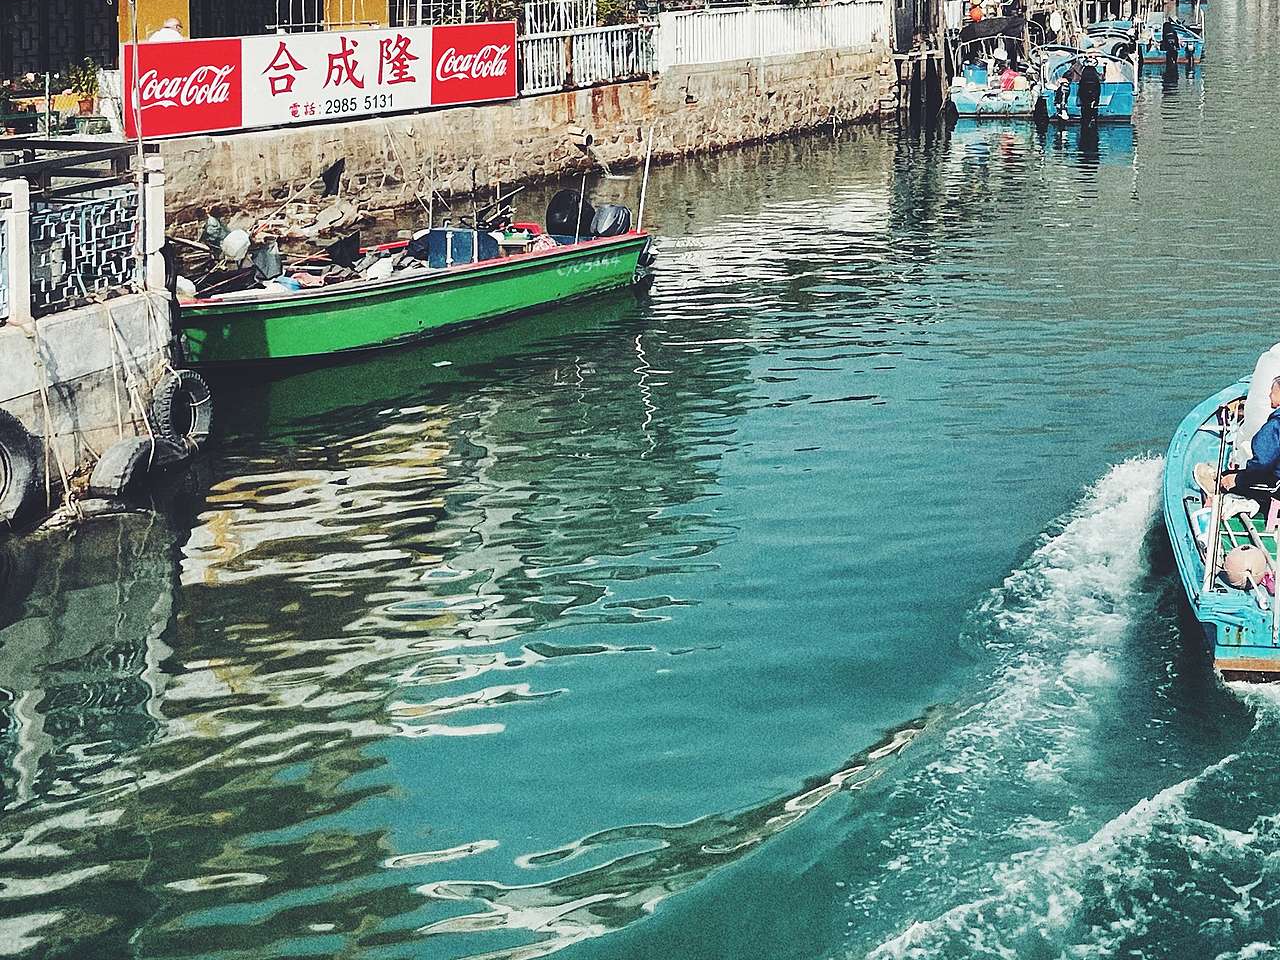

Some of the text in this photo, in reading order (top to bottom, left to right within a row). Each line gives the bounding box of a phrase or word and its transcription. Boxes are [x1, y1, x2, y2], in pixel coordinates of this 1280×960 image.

[260, 33, 419, 96] 合成隆
[435, 44, 511, 82] Coca-Cola
[131, 64, 235, 111] Coca-Cola
[325, 97, 357, 115] 2985
[364, 93, 393, 110] 5131
